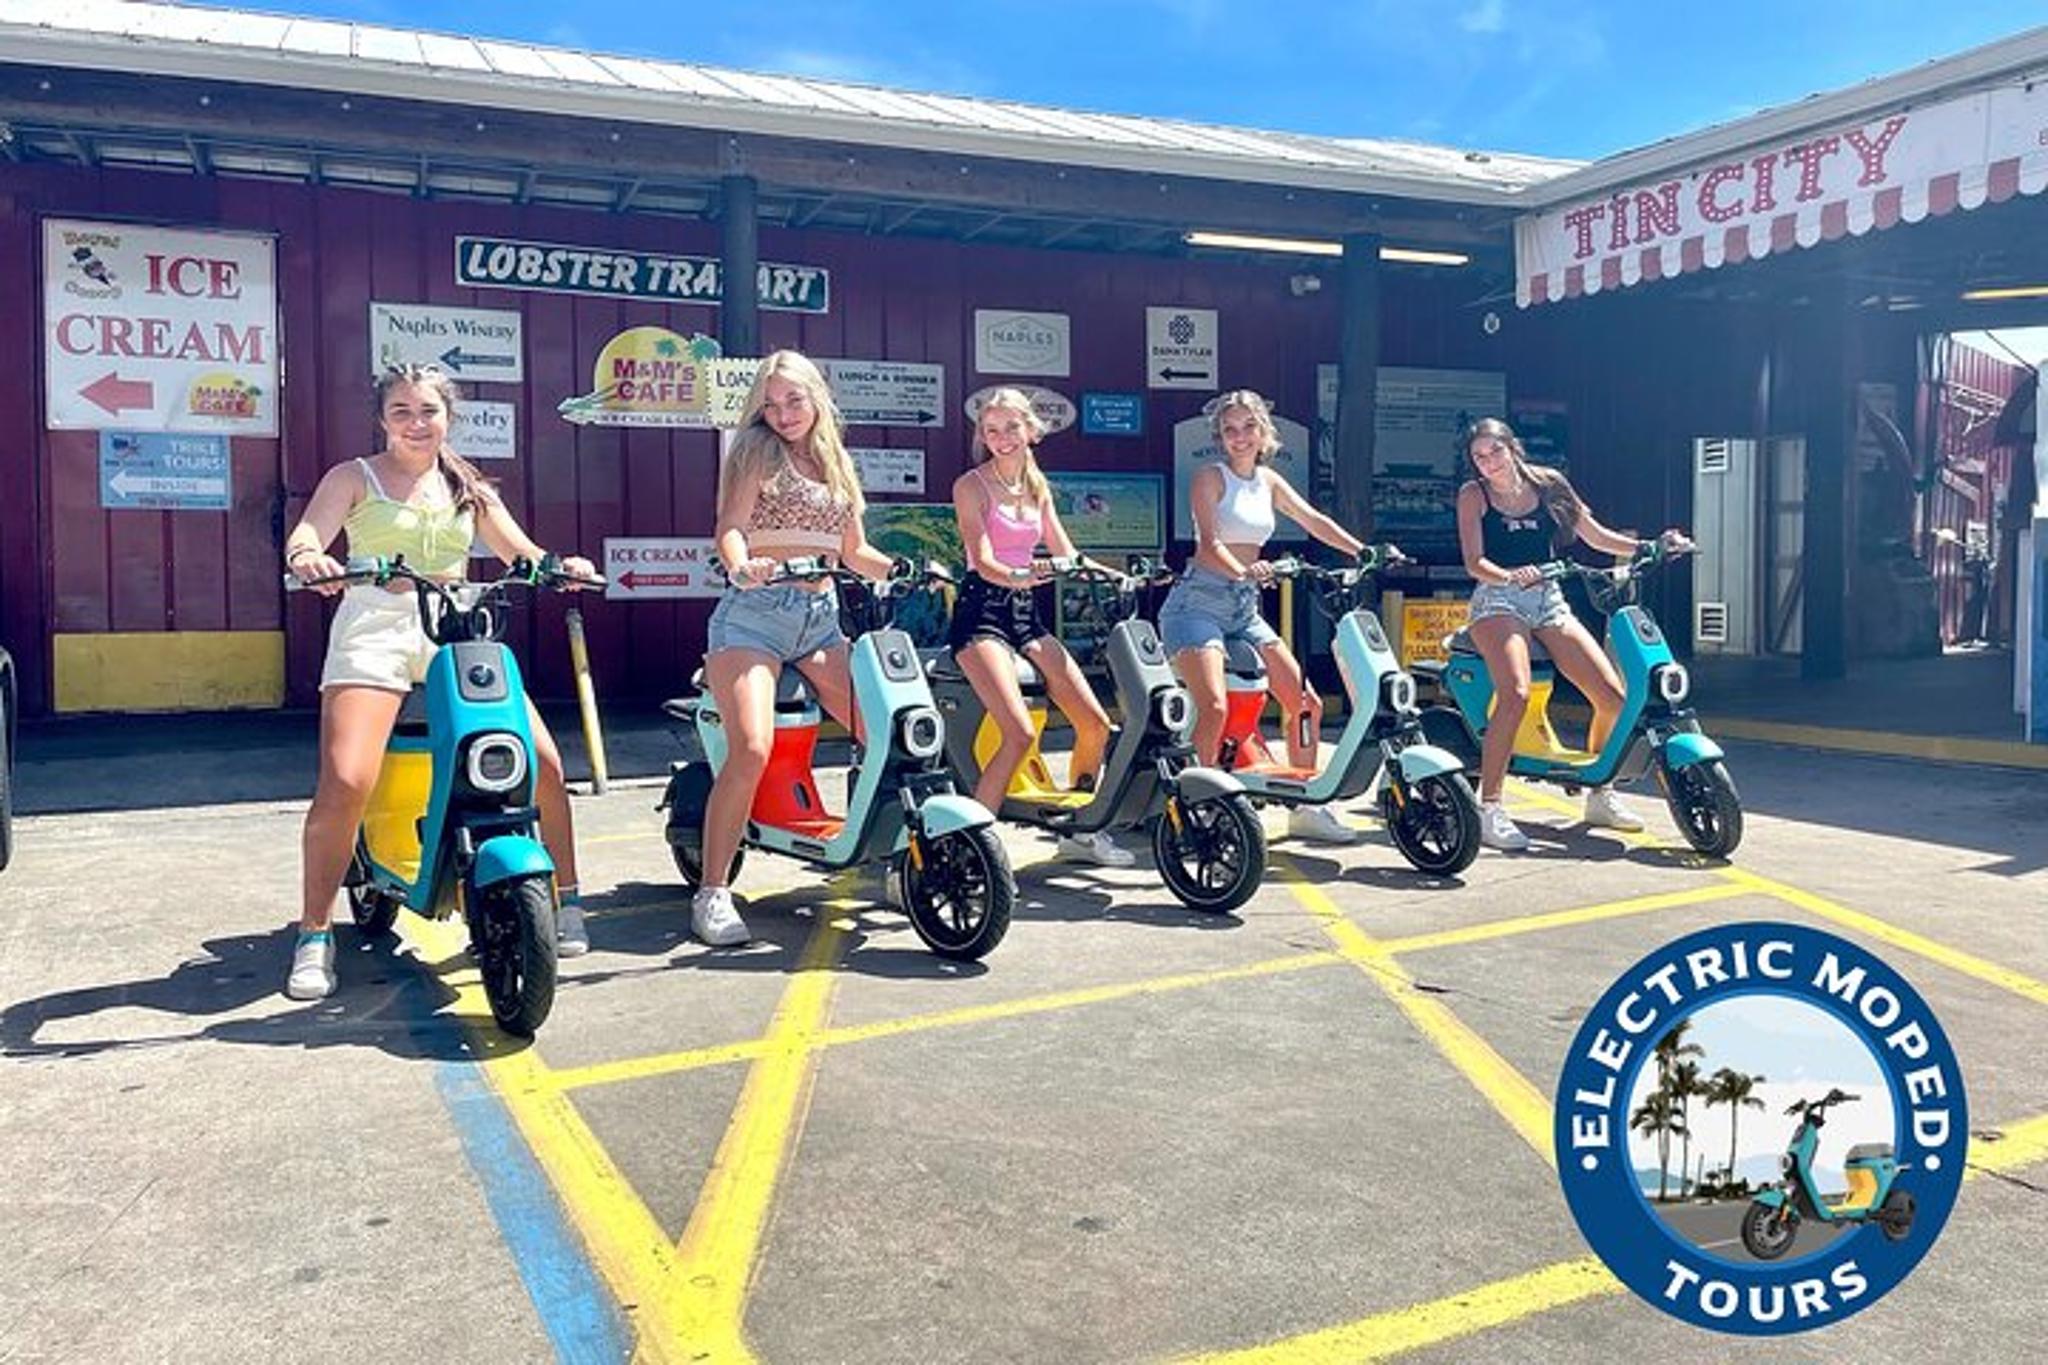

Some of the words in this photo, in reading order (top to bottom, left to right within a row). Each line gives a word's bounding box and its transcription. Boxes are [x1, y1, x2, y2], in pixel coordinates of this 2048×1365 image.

[1564, 181, 1683, 260] TIN
[1699, 115, 1907, 225] CITY
[144, 254, 242, 300] ICE
[467, 244, 640, 293] LOBSTER
[645, 258, 724, 297] TRA
[388, 315, 448, 338] Naples
[992, 330, 1053, 345] NAPLES
[56, 314, 267, 365] CREAM
[613, 358, 697, 382] M&M's
[838, 371, 878, 382] LUNCH
[881, 373, 889, 382] &
[617, 381, 694, 402] CAFE
[611, 548, 637, 562] ICE
[641, 548, 698, 562] CREAM
